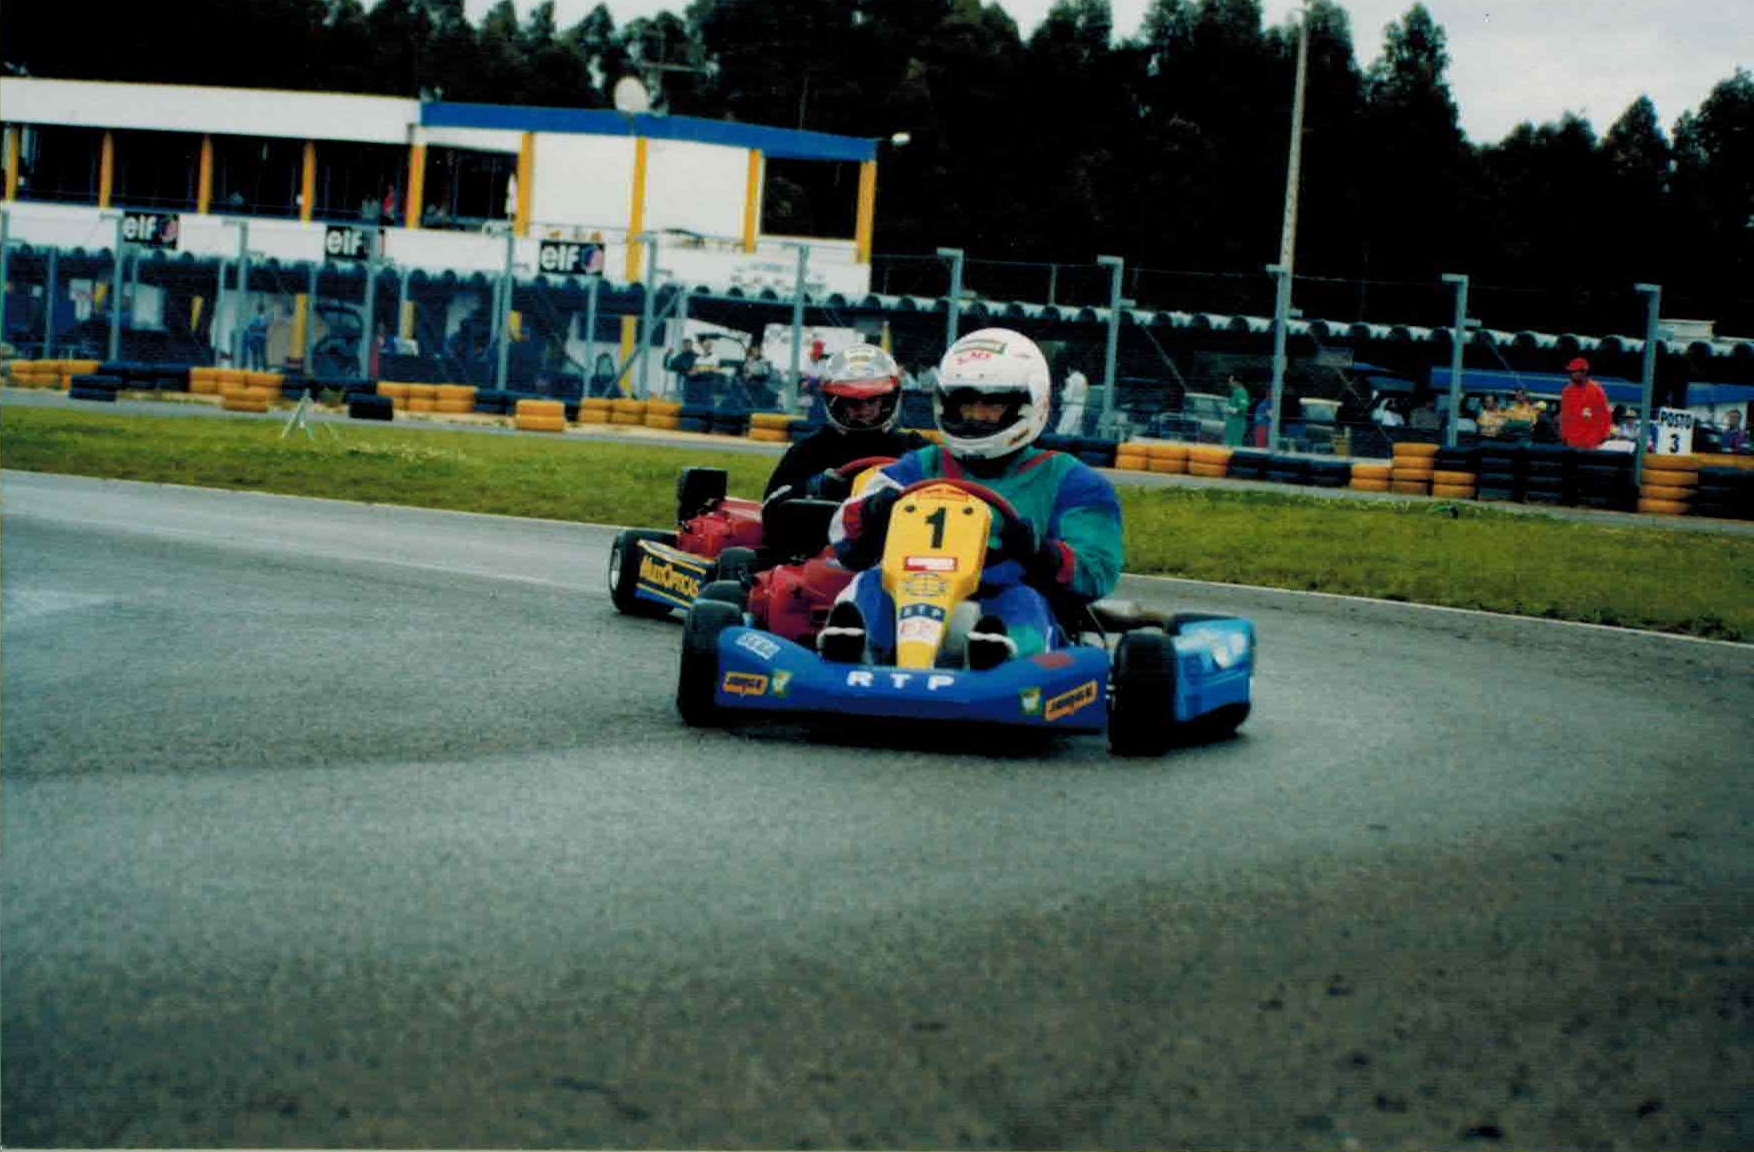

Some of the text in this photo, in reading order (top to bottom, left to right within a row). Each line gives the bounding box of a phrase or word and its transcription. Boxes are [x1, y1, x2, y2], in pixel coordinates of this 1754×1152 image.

[122, 214, 157, 241] elf
[327, 229, 362, 256] elf
[541, 245, 579, 271] elf
[1660, 411, 1691, 430] POSTO
[1669, 433, 1680, 454] 3
[925, 507, 946, 549] 1
